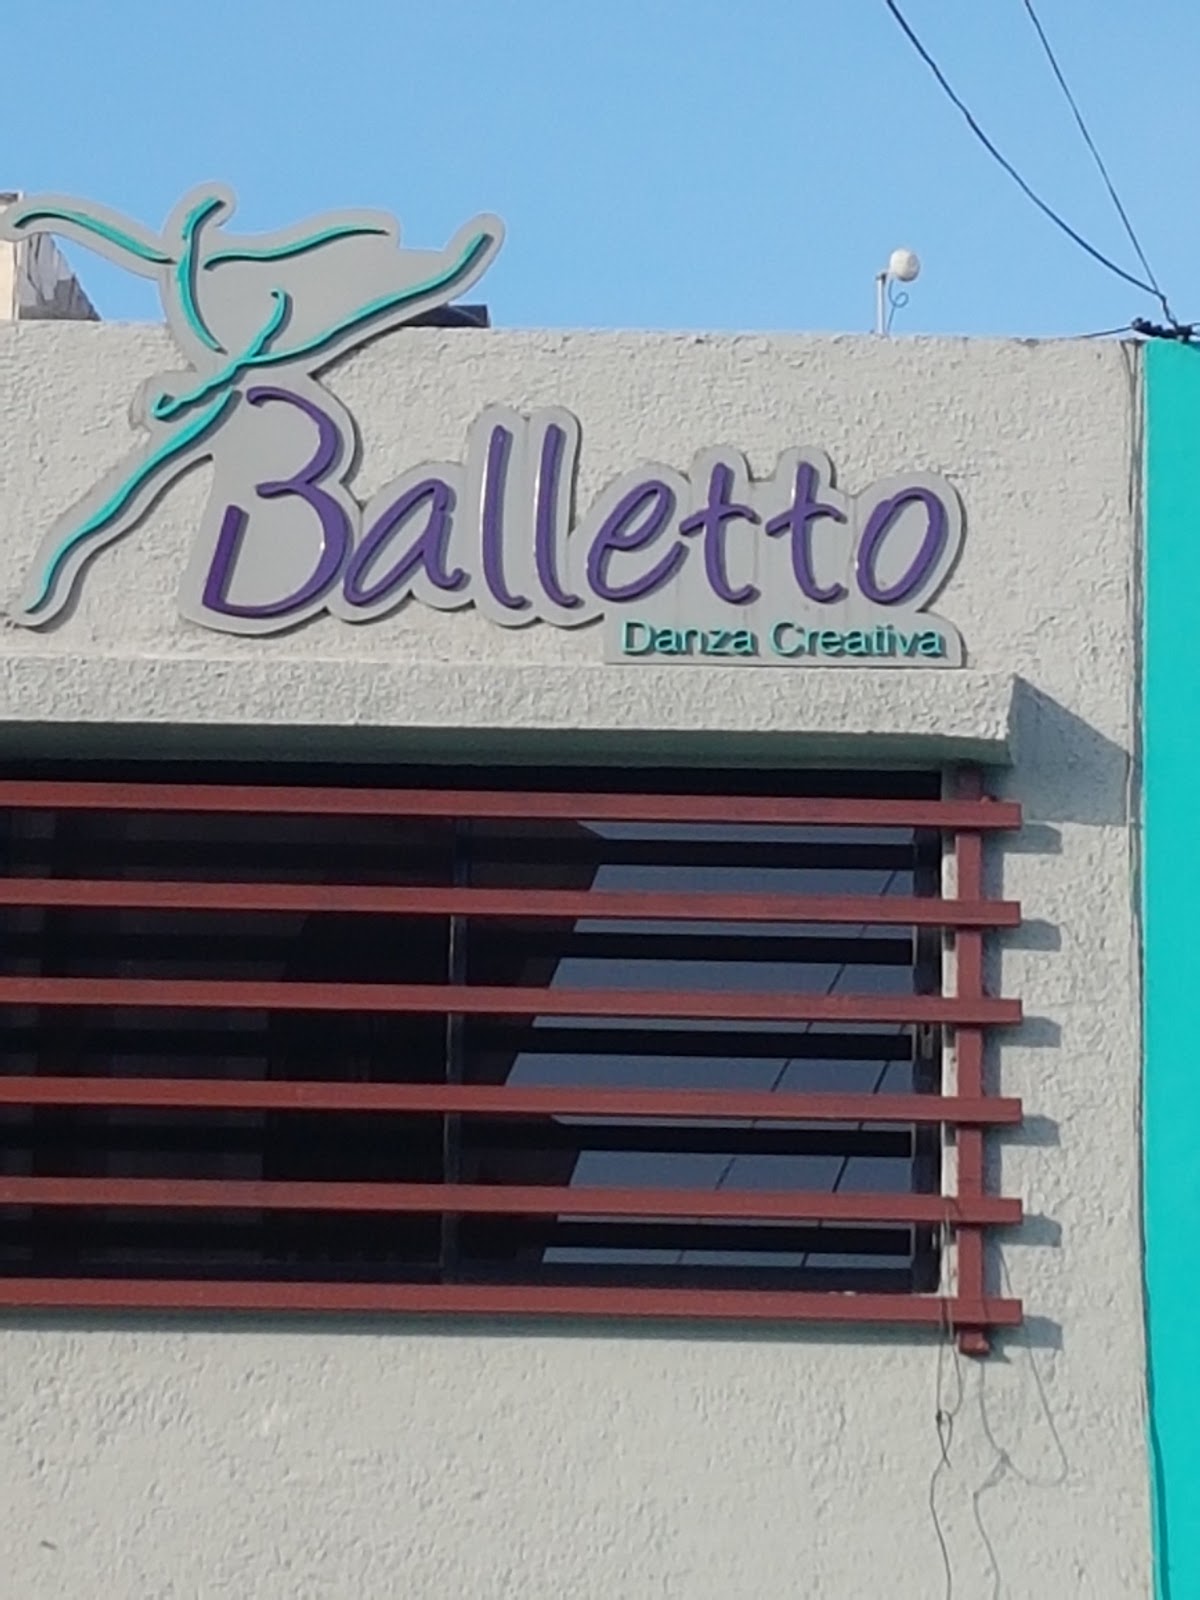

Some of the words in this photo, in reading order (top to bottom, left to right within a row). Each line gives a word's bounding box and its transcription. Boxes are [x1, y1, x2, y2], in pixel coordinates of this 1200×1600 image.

[202, 386, 946, 616] Balletto
[622, 621, 756, 656] Danza
[769, 622, 944, 657] Creativa
